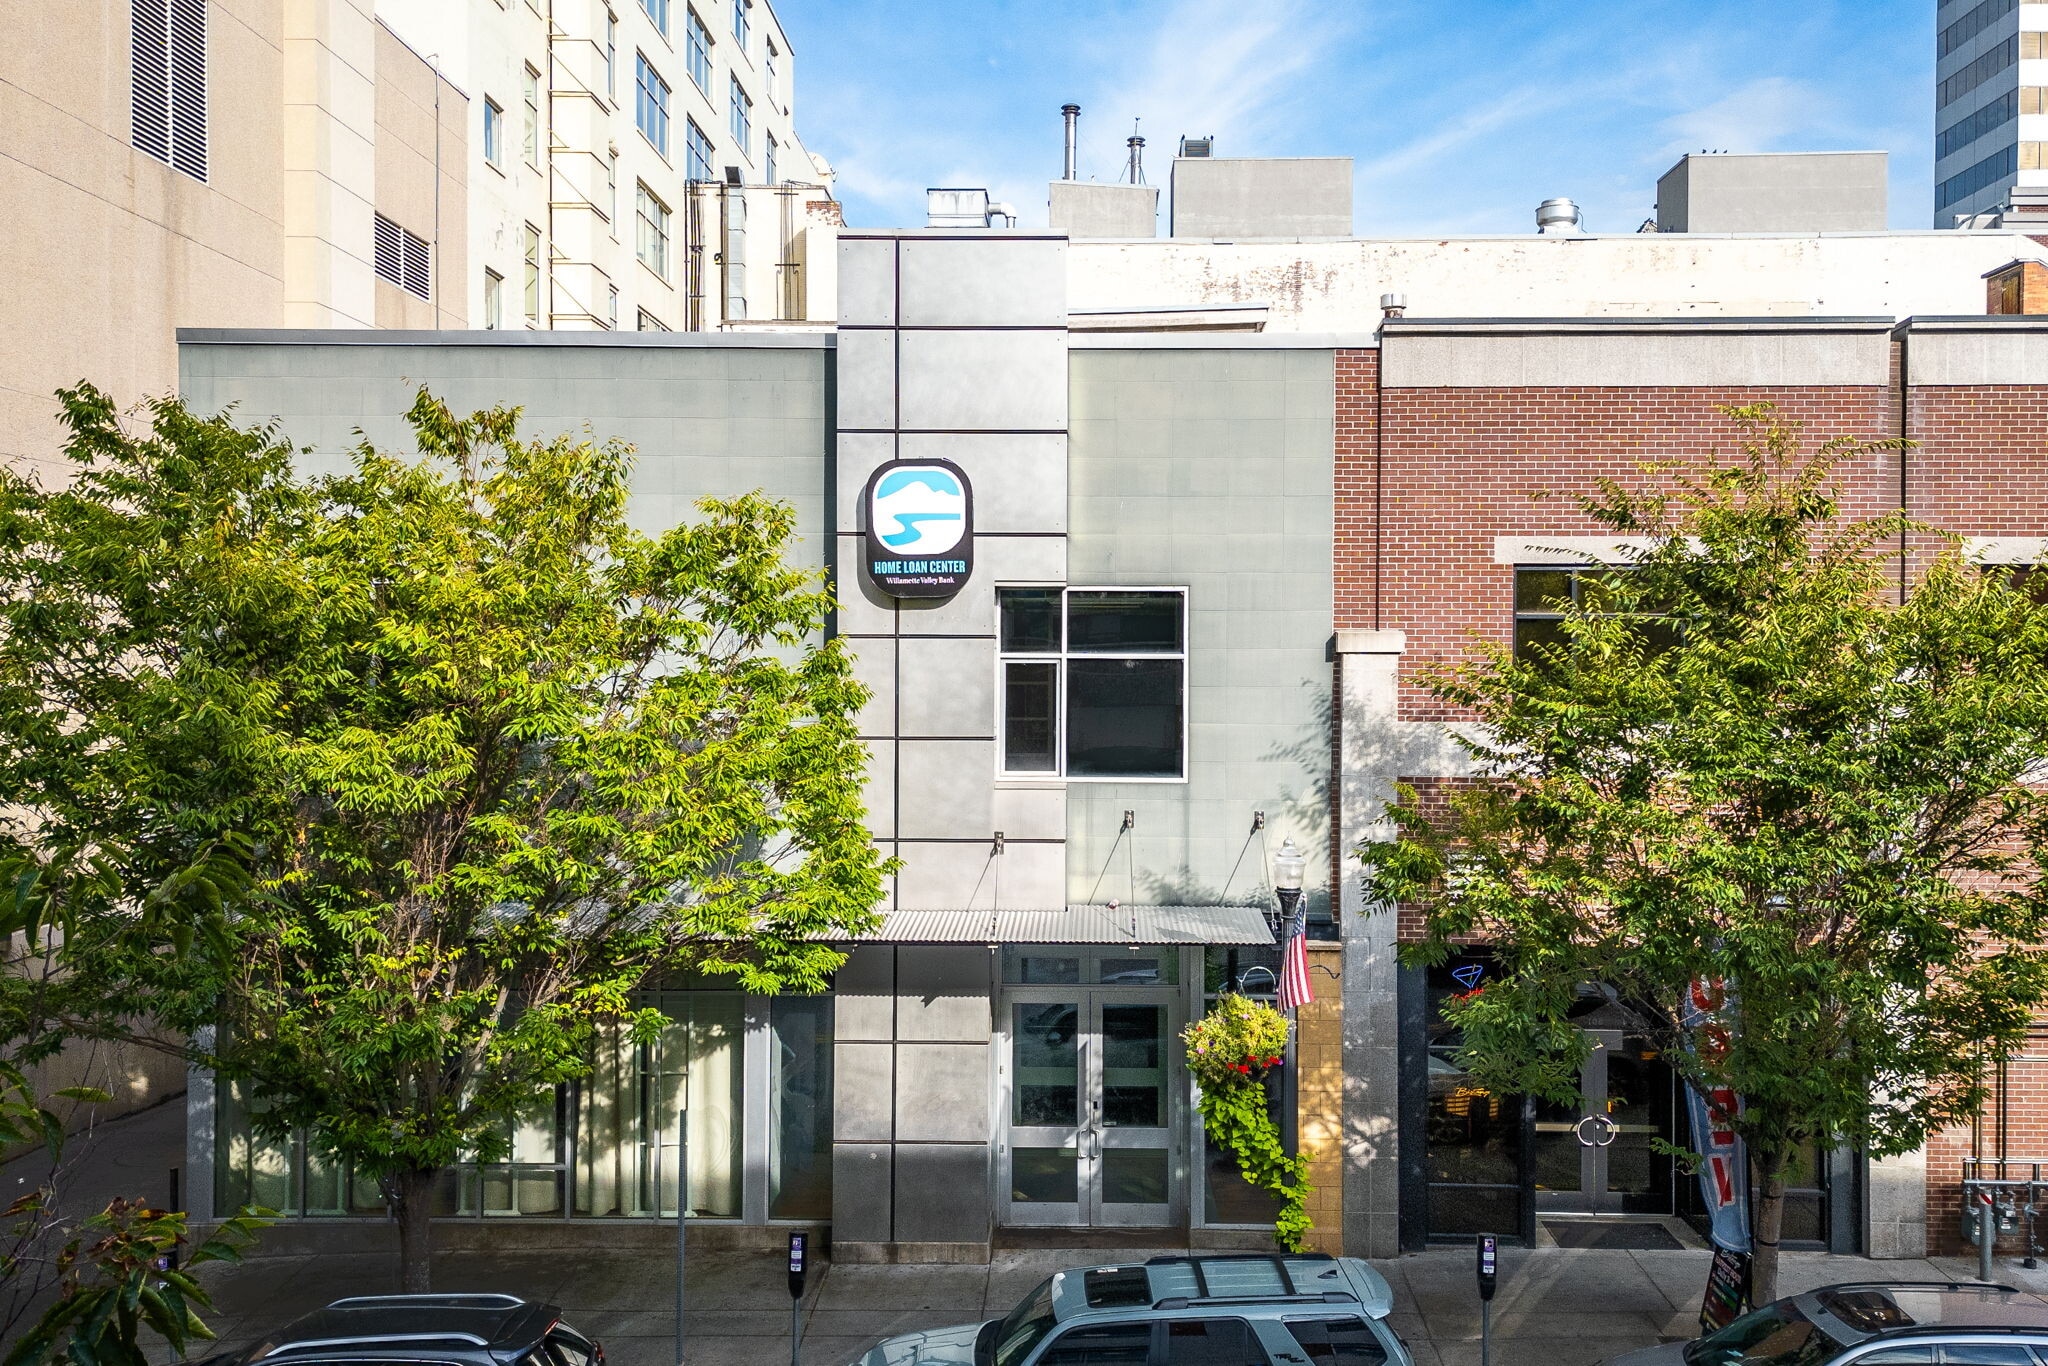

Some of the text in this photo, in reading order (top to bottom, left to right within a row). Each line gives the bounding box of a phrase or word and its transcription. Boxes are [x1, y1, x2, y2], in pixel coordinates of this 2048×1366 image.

[874, 560, 966, 574] HOME LOAN CENTER
[886, 577, 920, 585] Willamette
[920, 577, 939, 585] Valley
